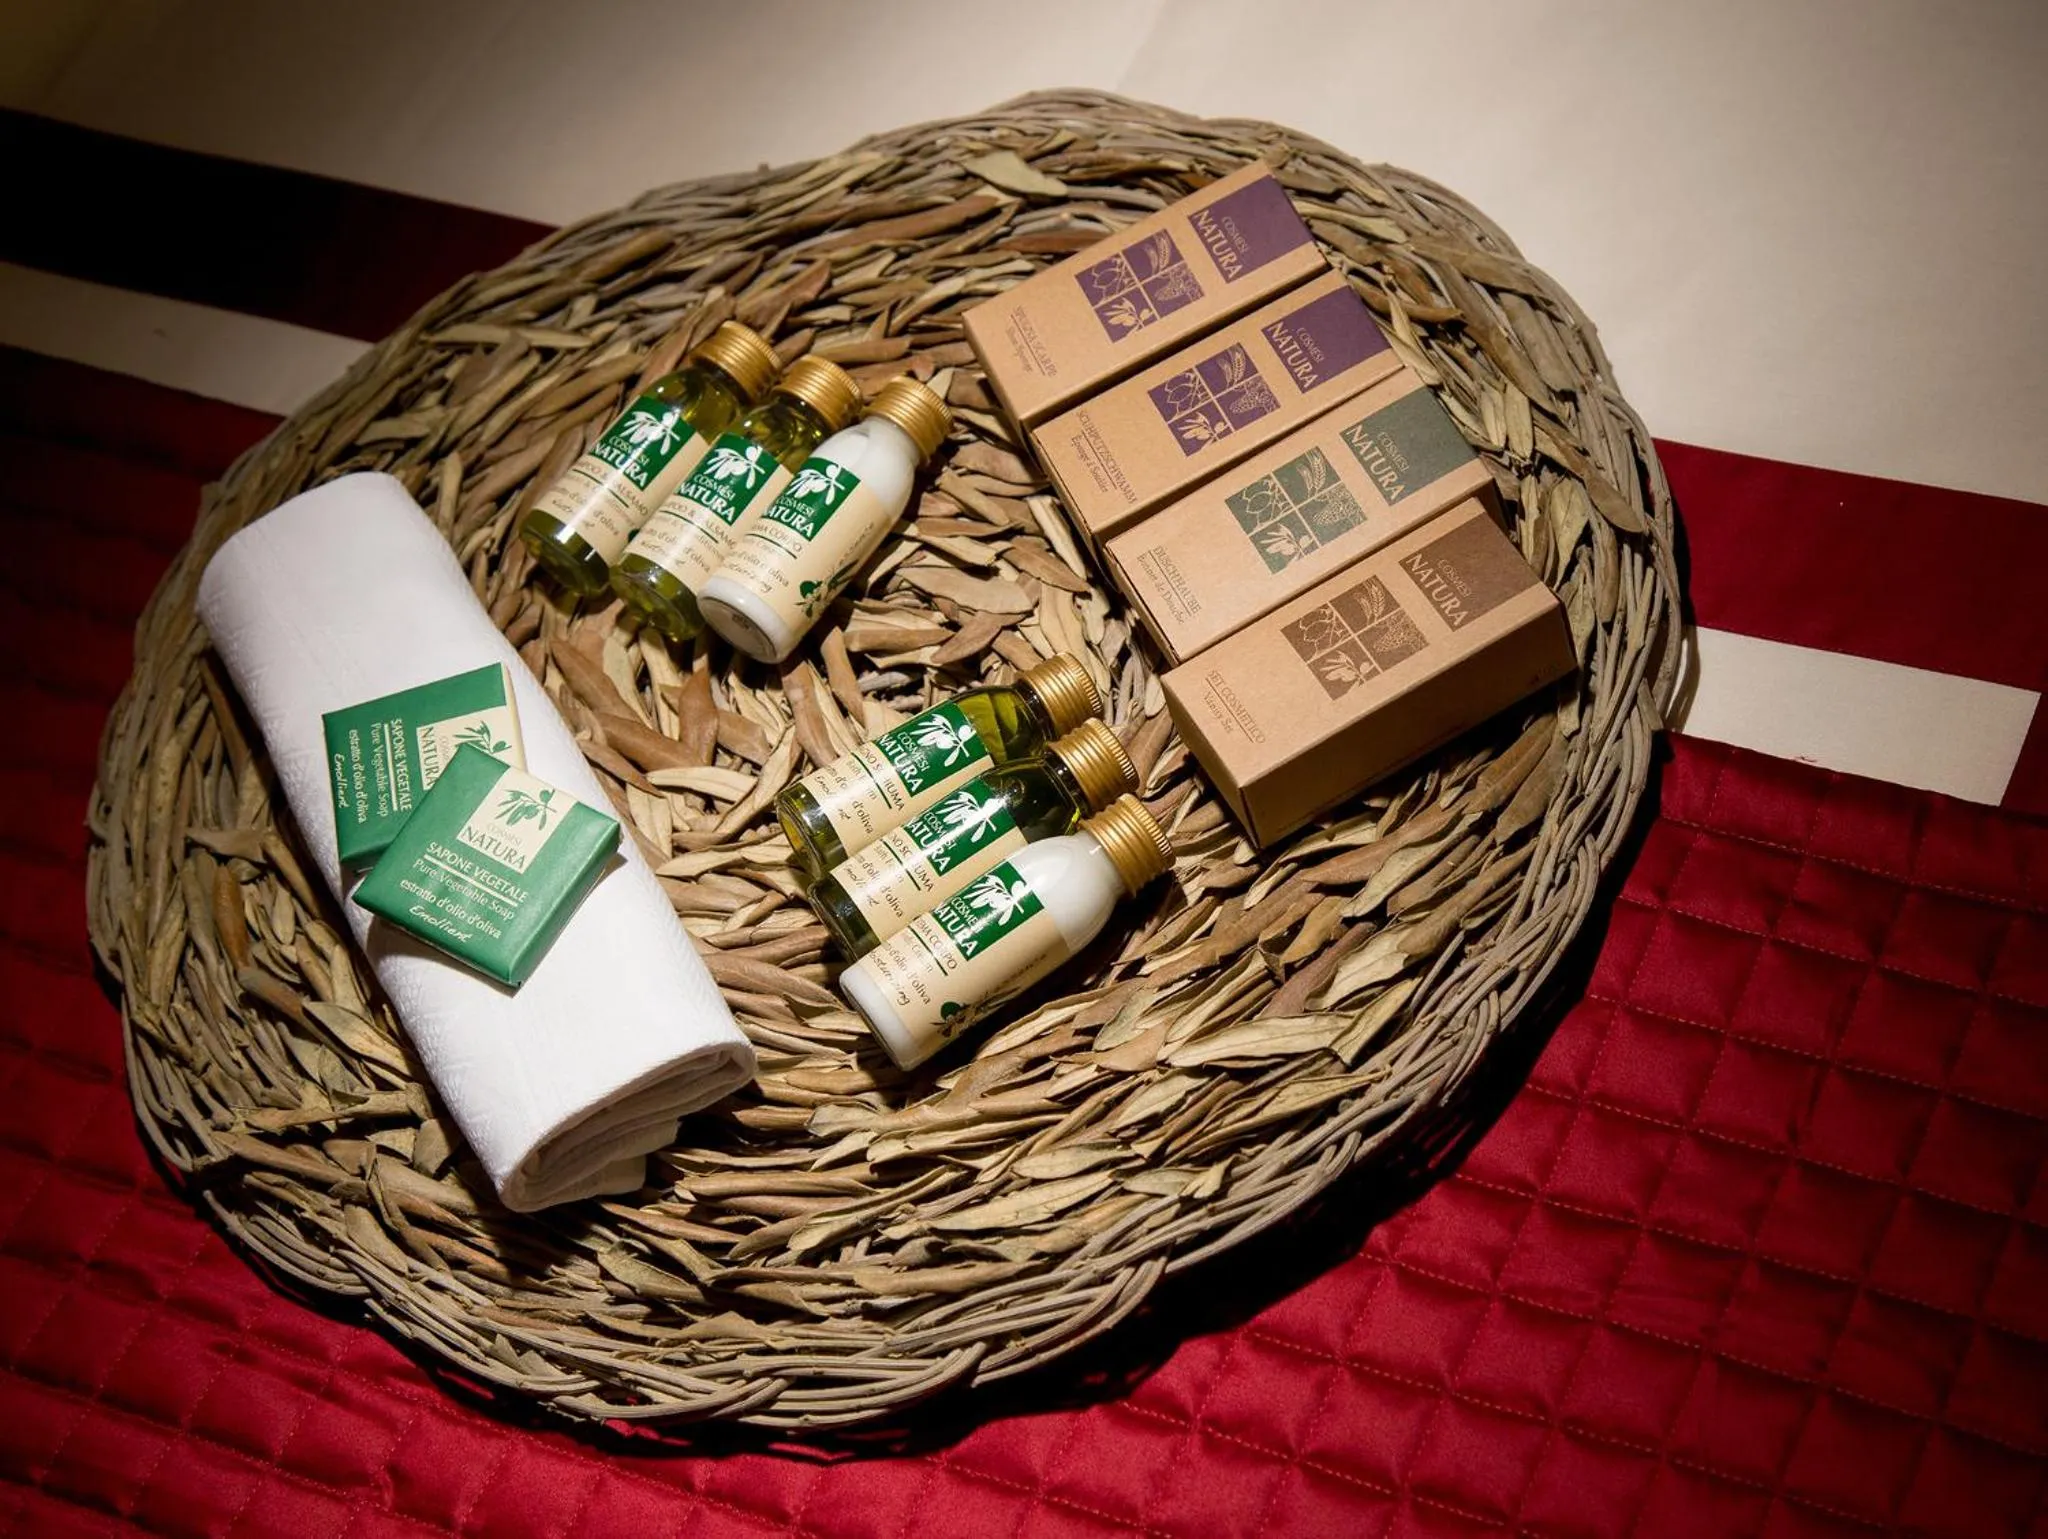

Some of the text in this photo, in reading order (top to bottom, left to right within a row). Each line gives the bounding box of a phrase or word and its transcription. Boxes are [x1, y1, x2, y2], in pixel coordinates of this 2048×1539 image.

[1193, 210, 1243, 278] NATURA
[1267, 321, 1318, 388] NATURA
[1296, 327, 1325, 363] COSMESI
[1346, 425, 1405, 499] NATURA
[1378, 432, 1409, 472] COSMESI
[1405, 553, 1469, 626] NATURA
[1208, 671, 1266, 743] SET COSMETICO
[334, 753, 349, 808] Emollient
[349, 729, 369, 823] estratto d'olio d'oliva
[371, 723, 390, 816] Pure Vegetable Soap
[391, 718, 412, 811] SAPONE VEGETALE
[421, 726, 440, 787] NATURA
[880, 734, 924, 792] NATURA
[897, 731, 931, 772] COSMESI
[851, 800, 874, 834] d'oliva
[924, 811, 957, 849] COSMSI
[427, 841, 529, 903] SAPONE VEGETALE
[461, 826, 526, 869] NATURA
[400, 880, 502, 939] estratto d'olio d'oliva
[413, 859, 514, 921] Pure Vegetable Soap
[881, 886, 903, 918] d'oliva
[409, 905, 473, 943] Emollient
